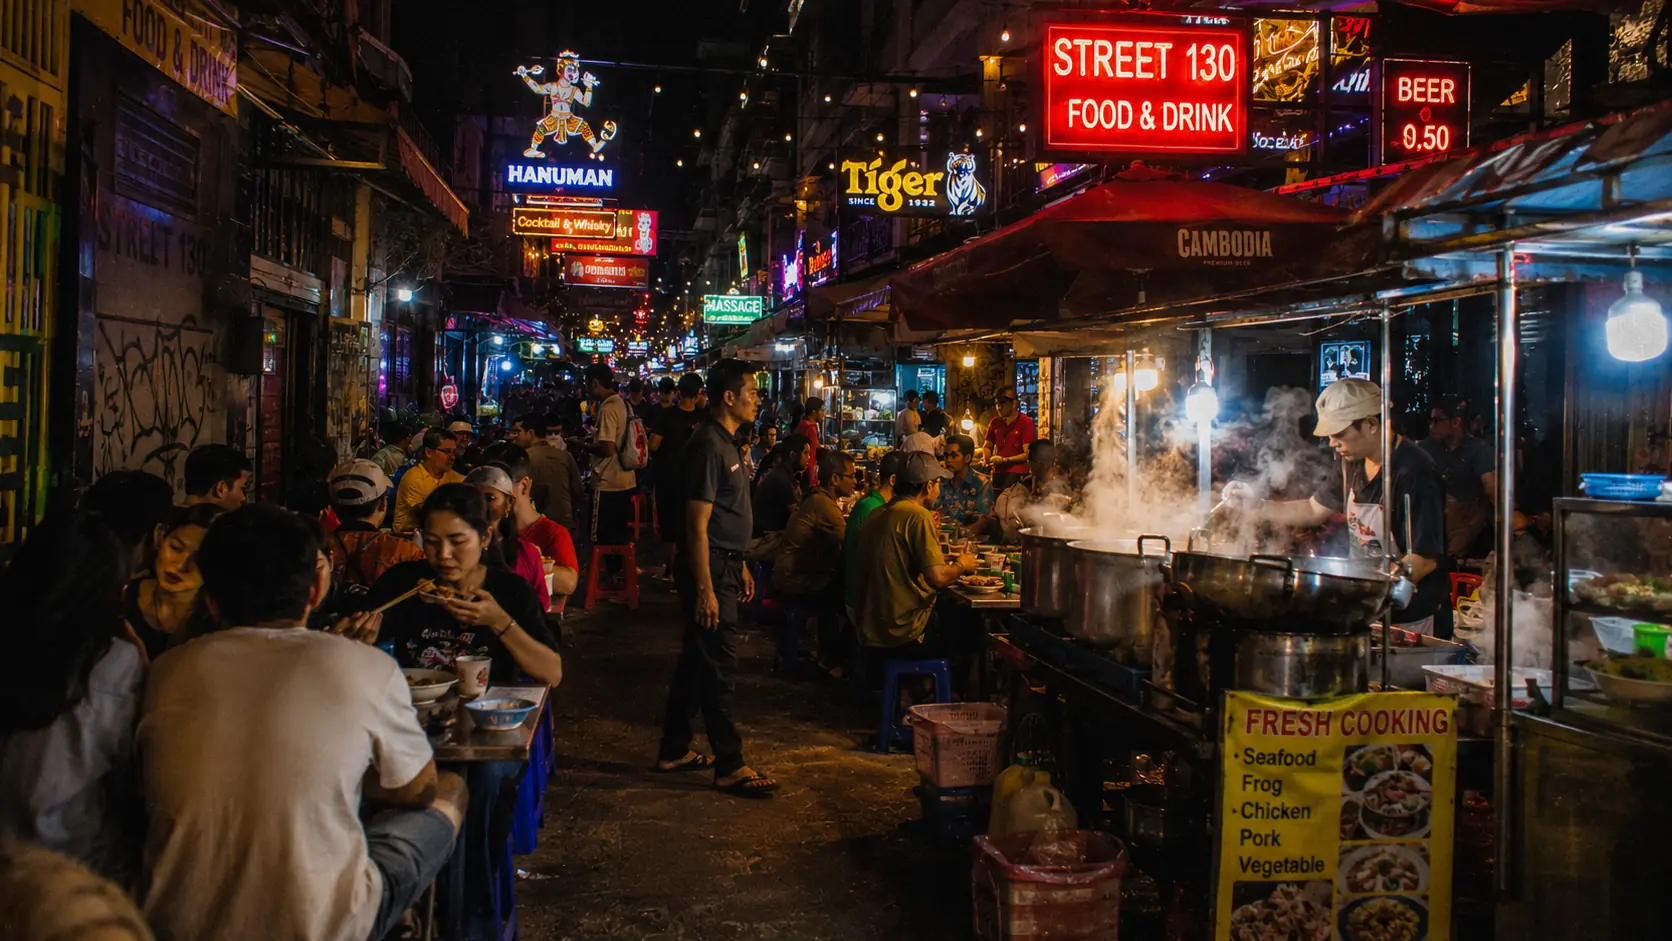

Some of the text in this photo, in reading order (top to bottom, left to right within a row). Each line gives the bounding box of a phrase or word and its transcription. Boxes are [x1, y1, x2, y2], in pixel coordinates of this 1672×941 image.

[122, 0, 167, 61] FOOD
[173, 27, 183, 74] &
[1053, 37, 1174, 81] STREET
[1186, 43, 1236, 82] 130
[1398, 76, 1455, 103] BEER
[1067, 98, 1234, 133] FOOD & DRINK
[507, 164, 613, 187] HANUMAN
[841, 157, 944, 212] Tiger
[848, 197, 936, 207] SINCE 1932
[517, 215, 560, 229] Cocktail
[563, 218, 574, 231] &
[179, 230, 207, 279] 130
[1176, 228, 1274, 258] CAMBODIA
[704, 299, 761, 313] MASSAGE
[1245, 708, 1448, 737] FRESH COOKING
[1243, 747, 1316, 766] Seafood
[1242, 774, 1283, 797] Frog
[1241, 802, 1311, 820] Chicken
[1240, 830, 1281, 847] Pork
[1239, 855, 1325, 878] Vegetable
